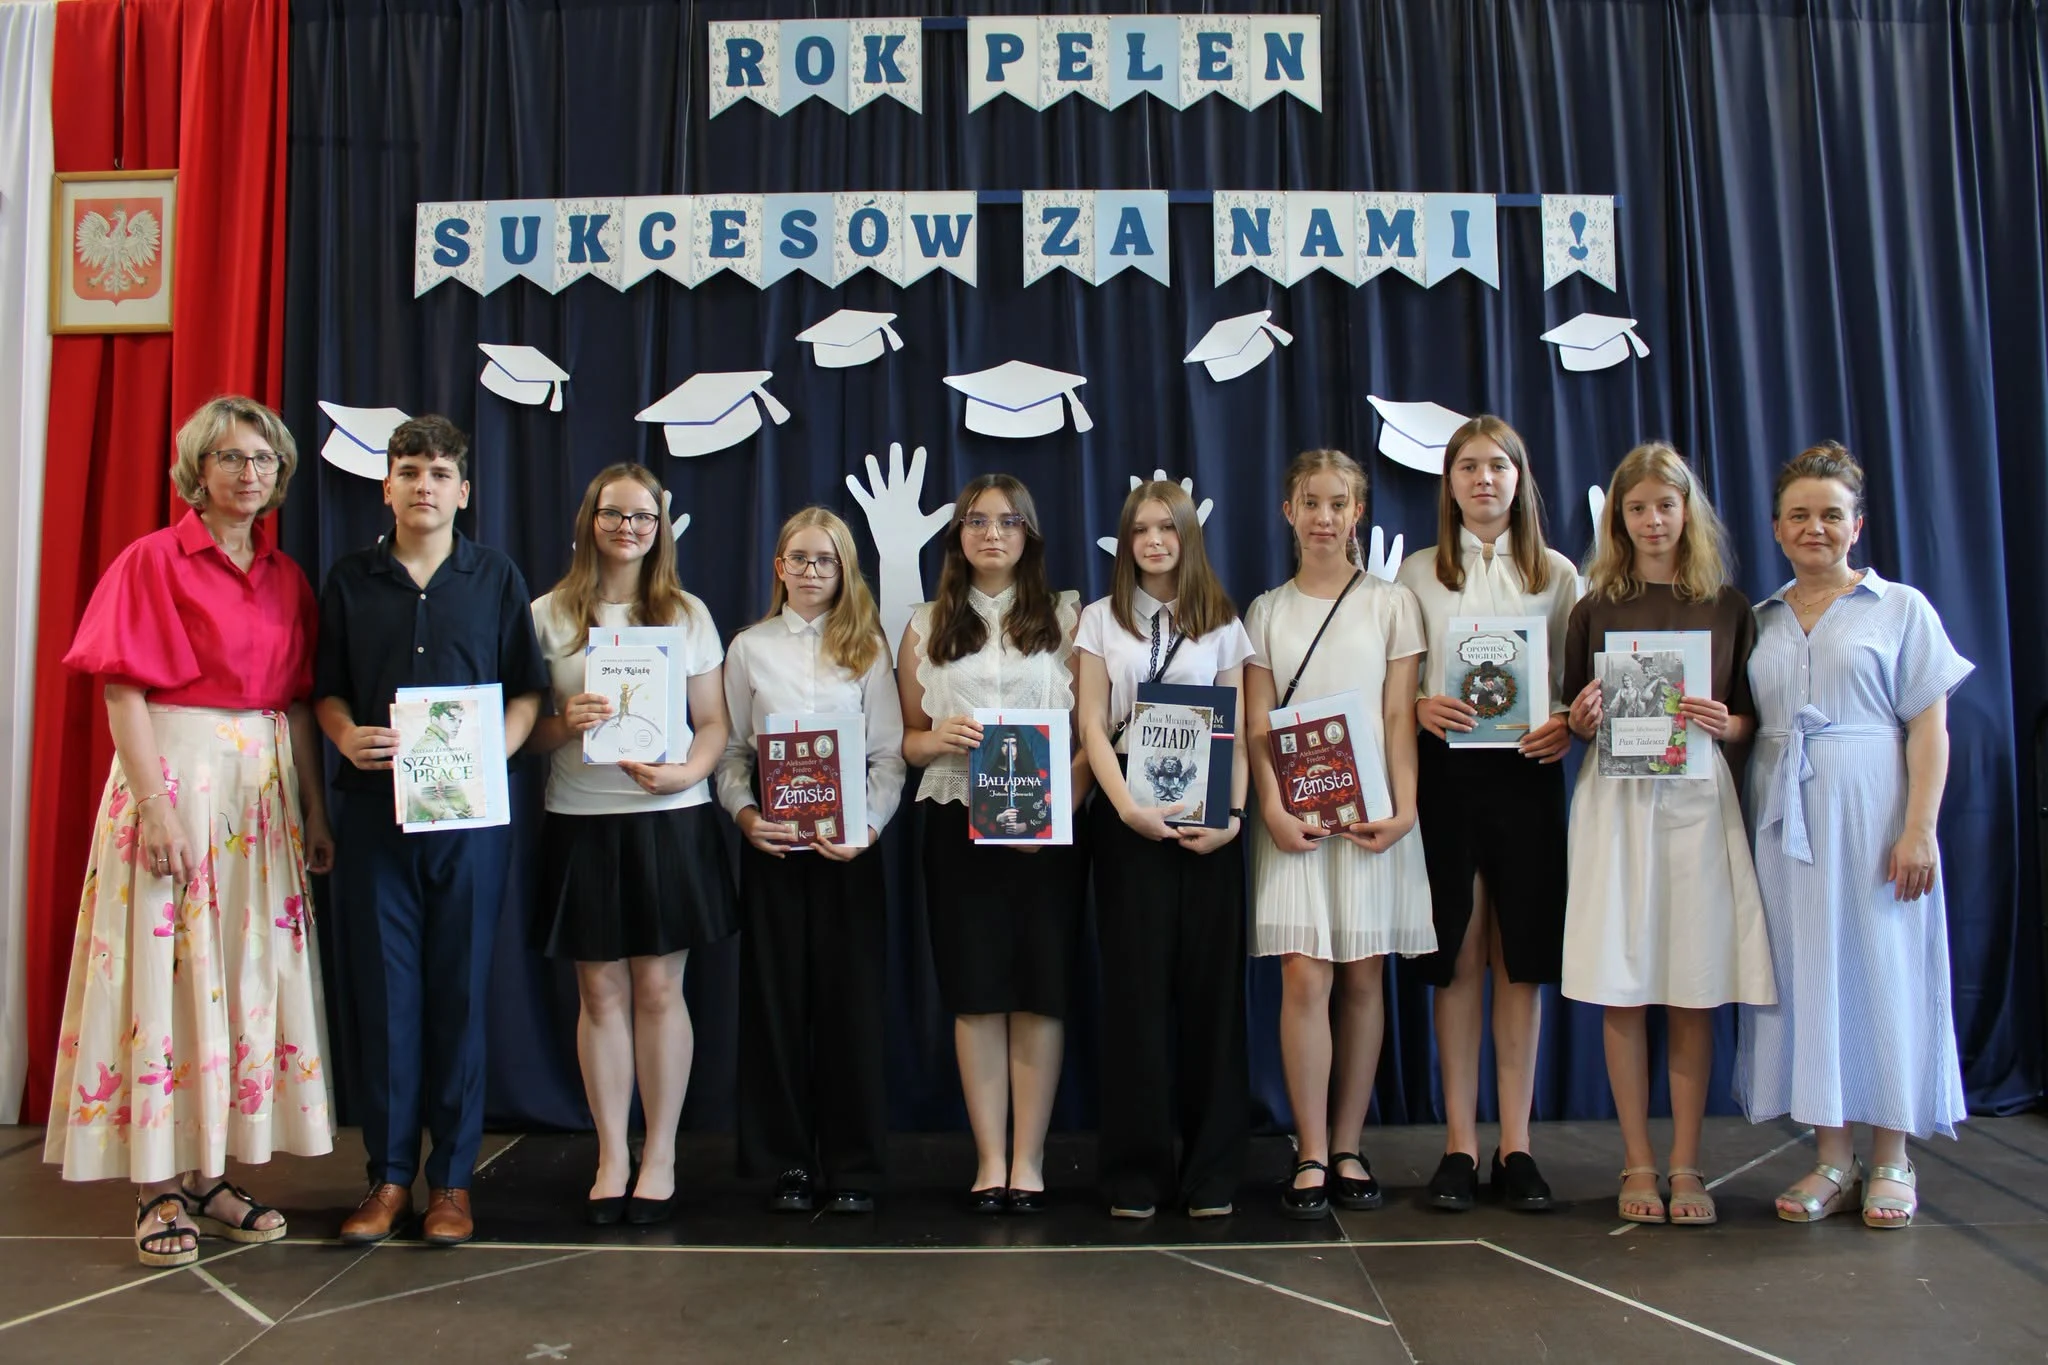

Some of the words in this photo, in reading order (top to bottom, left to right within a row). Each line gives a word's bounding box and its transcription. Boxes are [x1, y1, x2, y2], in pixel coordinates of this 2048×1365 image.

[725, 33, 906, 88] ROK
[985, 32, 1305, 82] PELEN
[433, 199, 973, 268] SUKCESÓW
[1041, 206, 1155, 256] ZA
[1230, 207, 1472, 259] NAMI
[601, 666, 622, 676] Mały
[1141, 725, 1201, 751] DZIADY
[1618, 738, 1634, 746] Pan
[1636, 737, 1665, 746] Tadeusz
[402, 752, 473, 773] SYZYFOWE
[413, 765, 474, 783] PRACE
[977, 773, 1042, 788] BALLADYNA
[1293, 771, 1353, 803] Zemsta
[774, 785, 836, 810] Zemsta
